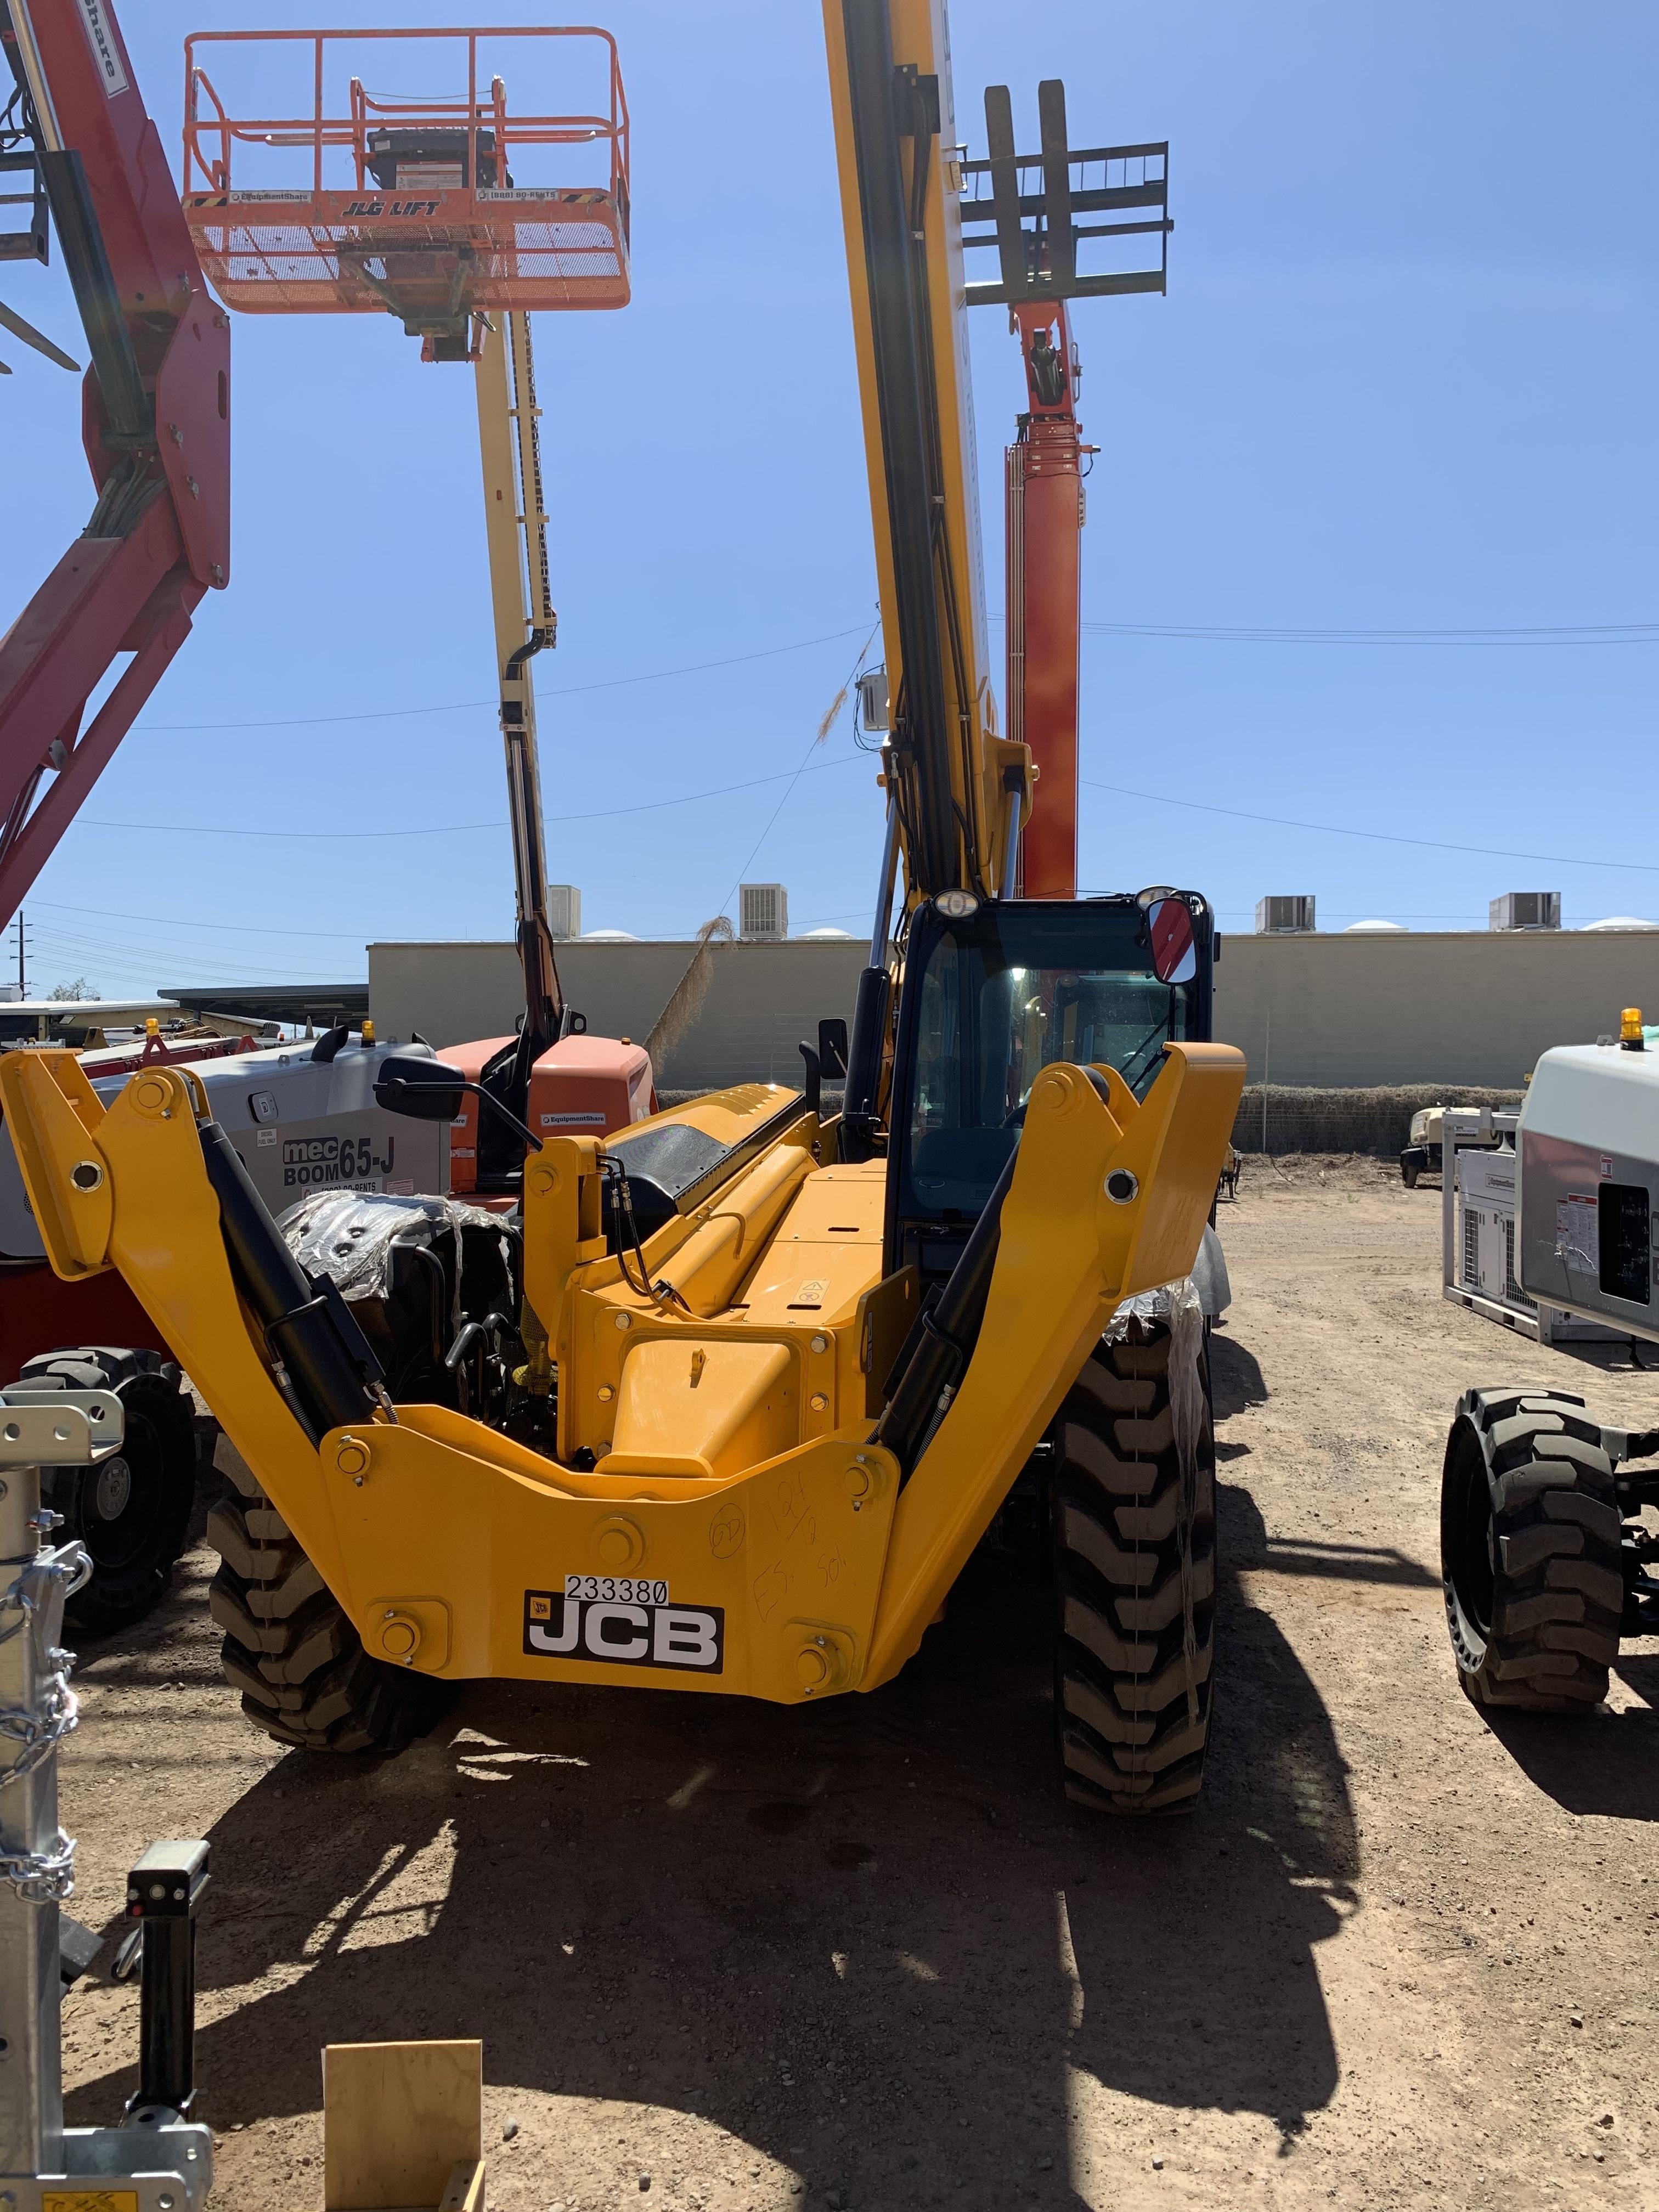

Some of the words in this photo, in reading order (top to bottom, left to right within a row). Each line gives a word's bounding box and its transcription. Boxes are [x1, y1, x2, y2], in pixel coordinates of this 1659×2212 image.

[341, 201, 386, 216] JLG
[388, 201, 441, 216] LIFT
[284, 1141, 338, 1163] mec
[284, 1163, 338, 1186] BOOM
[340, 1136, 394, 1179] 65-J
[567, 1576, 668, 1604] 233380
[529, 1600, 718, 1666] JCB
